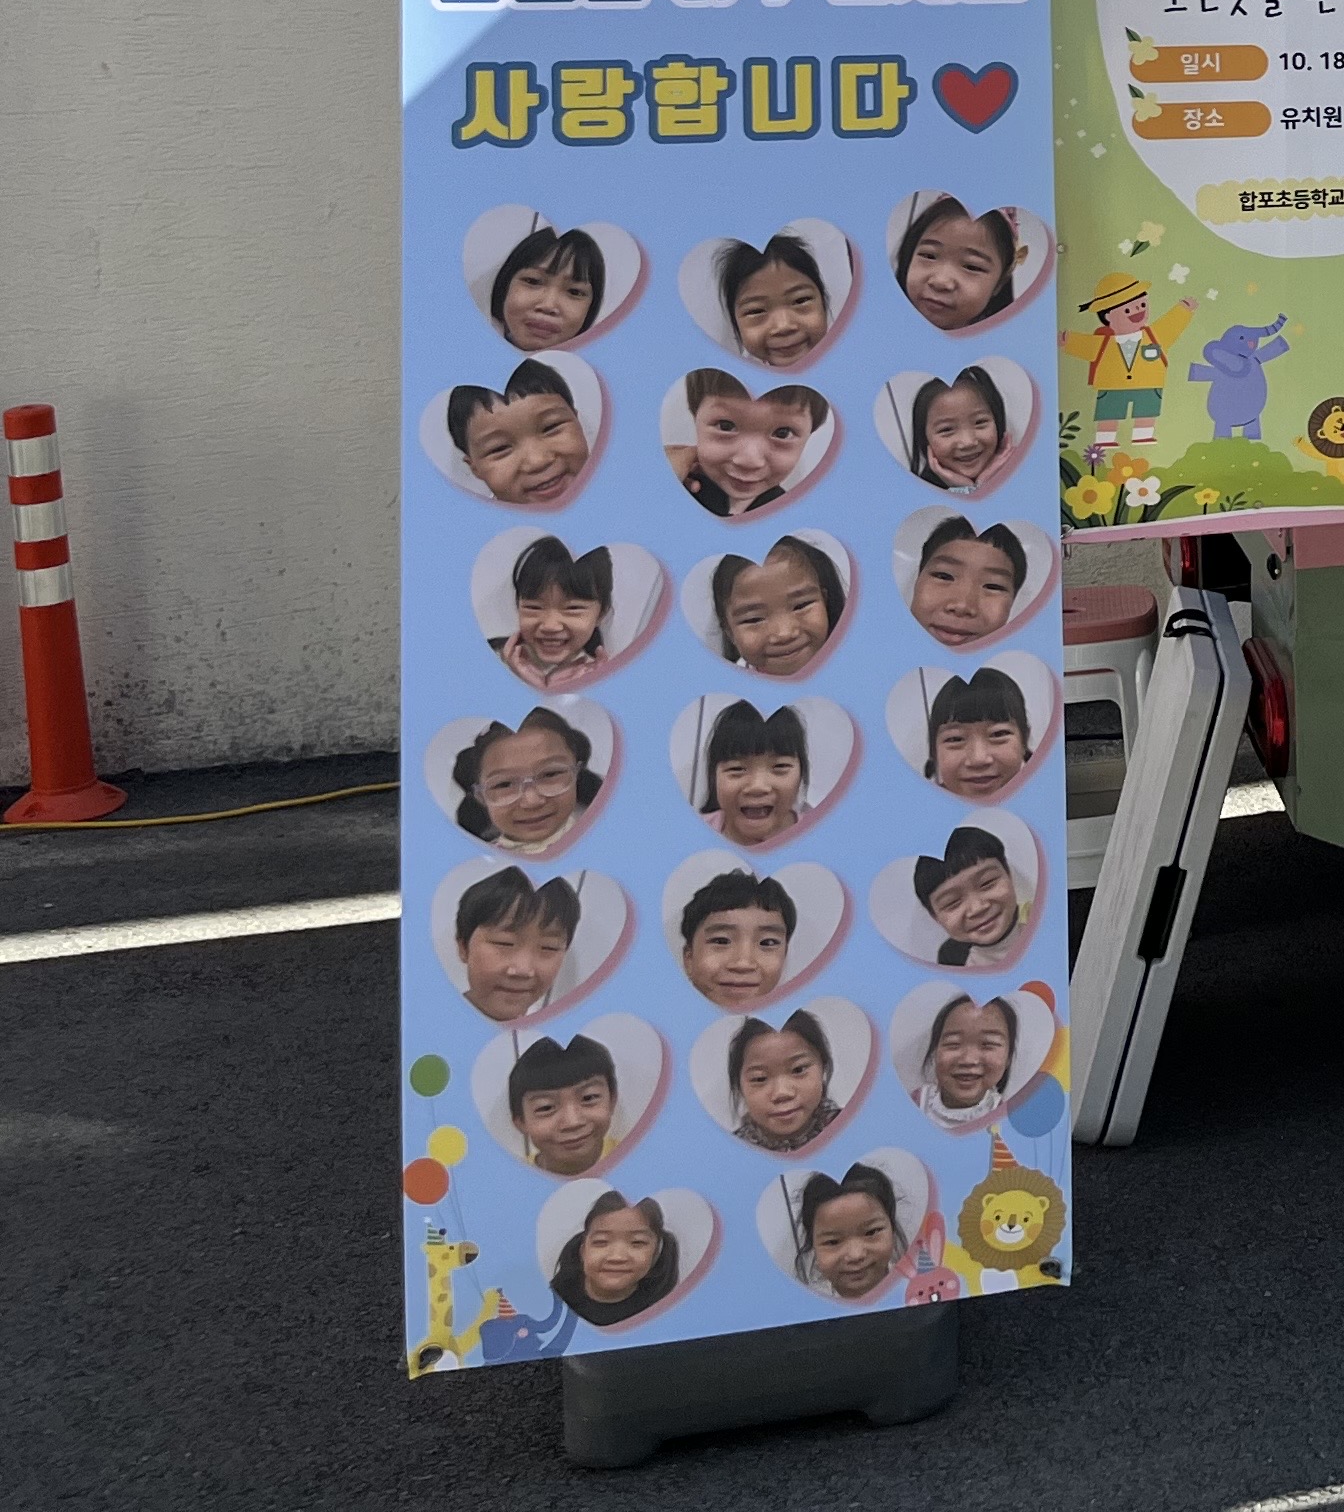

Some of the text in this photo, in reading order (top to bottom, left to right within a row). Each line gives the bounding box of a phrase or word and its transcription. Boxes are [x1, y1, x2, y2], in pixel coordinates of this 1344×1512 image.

[1180, 52, 1221, 75] 일시
[1279, 52, 1312, 71] 10.
[455, 56, 915, 146] 사랑합니다
[1183, 108, 1225, 131] 장소
[1280, 106, 1342, 129] 유치원
